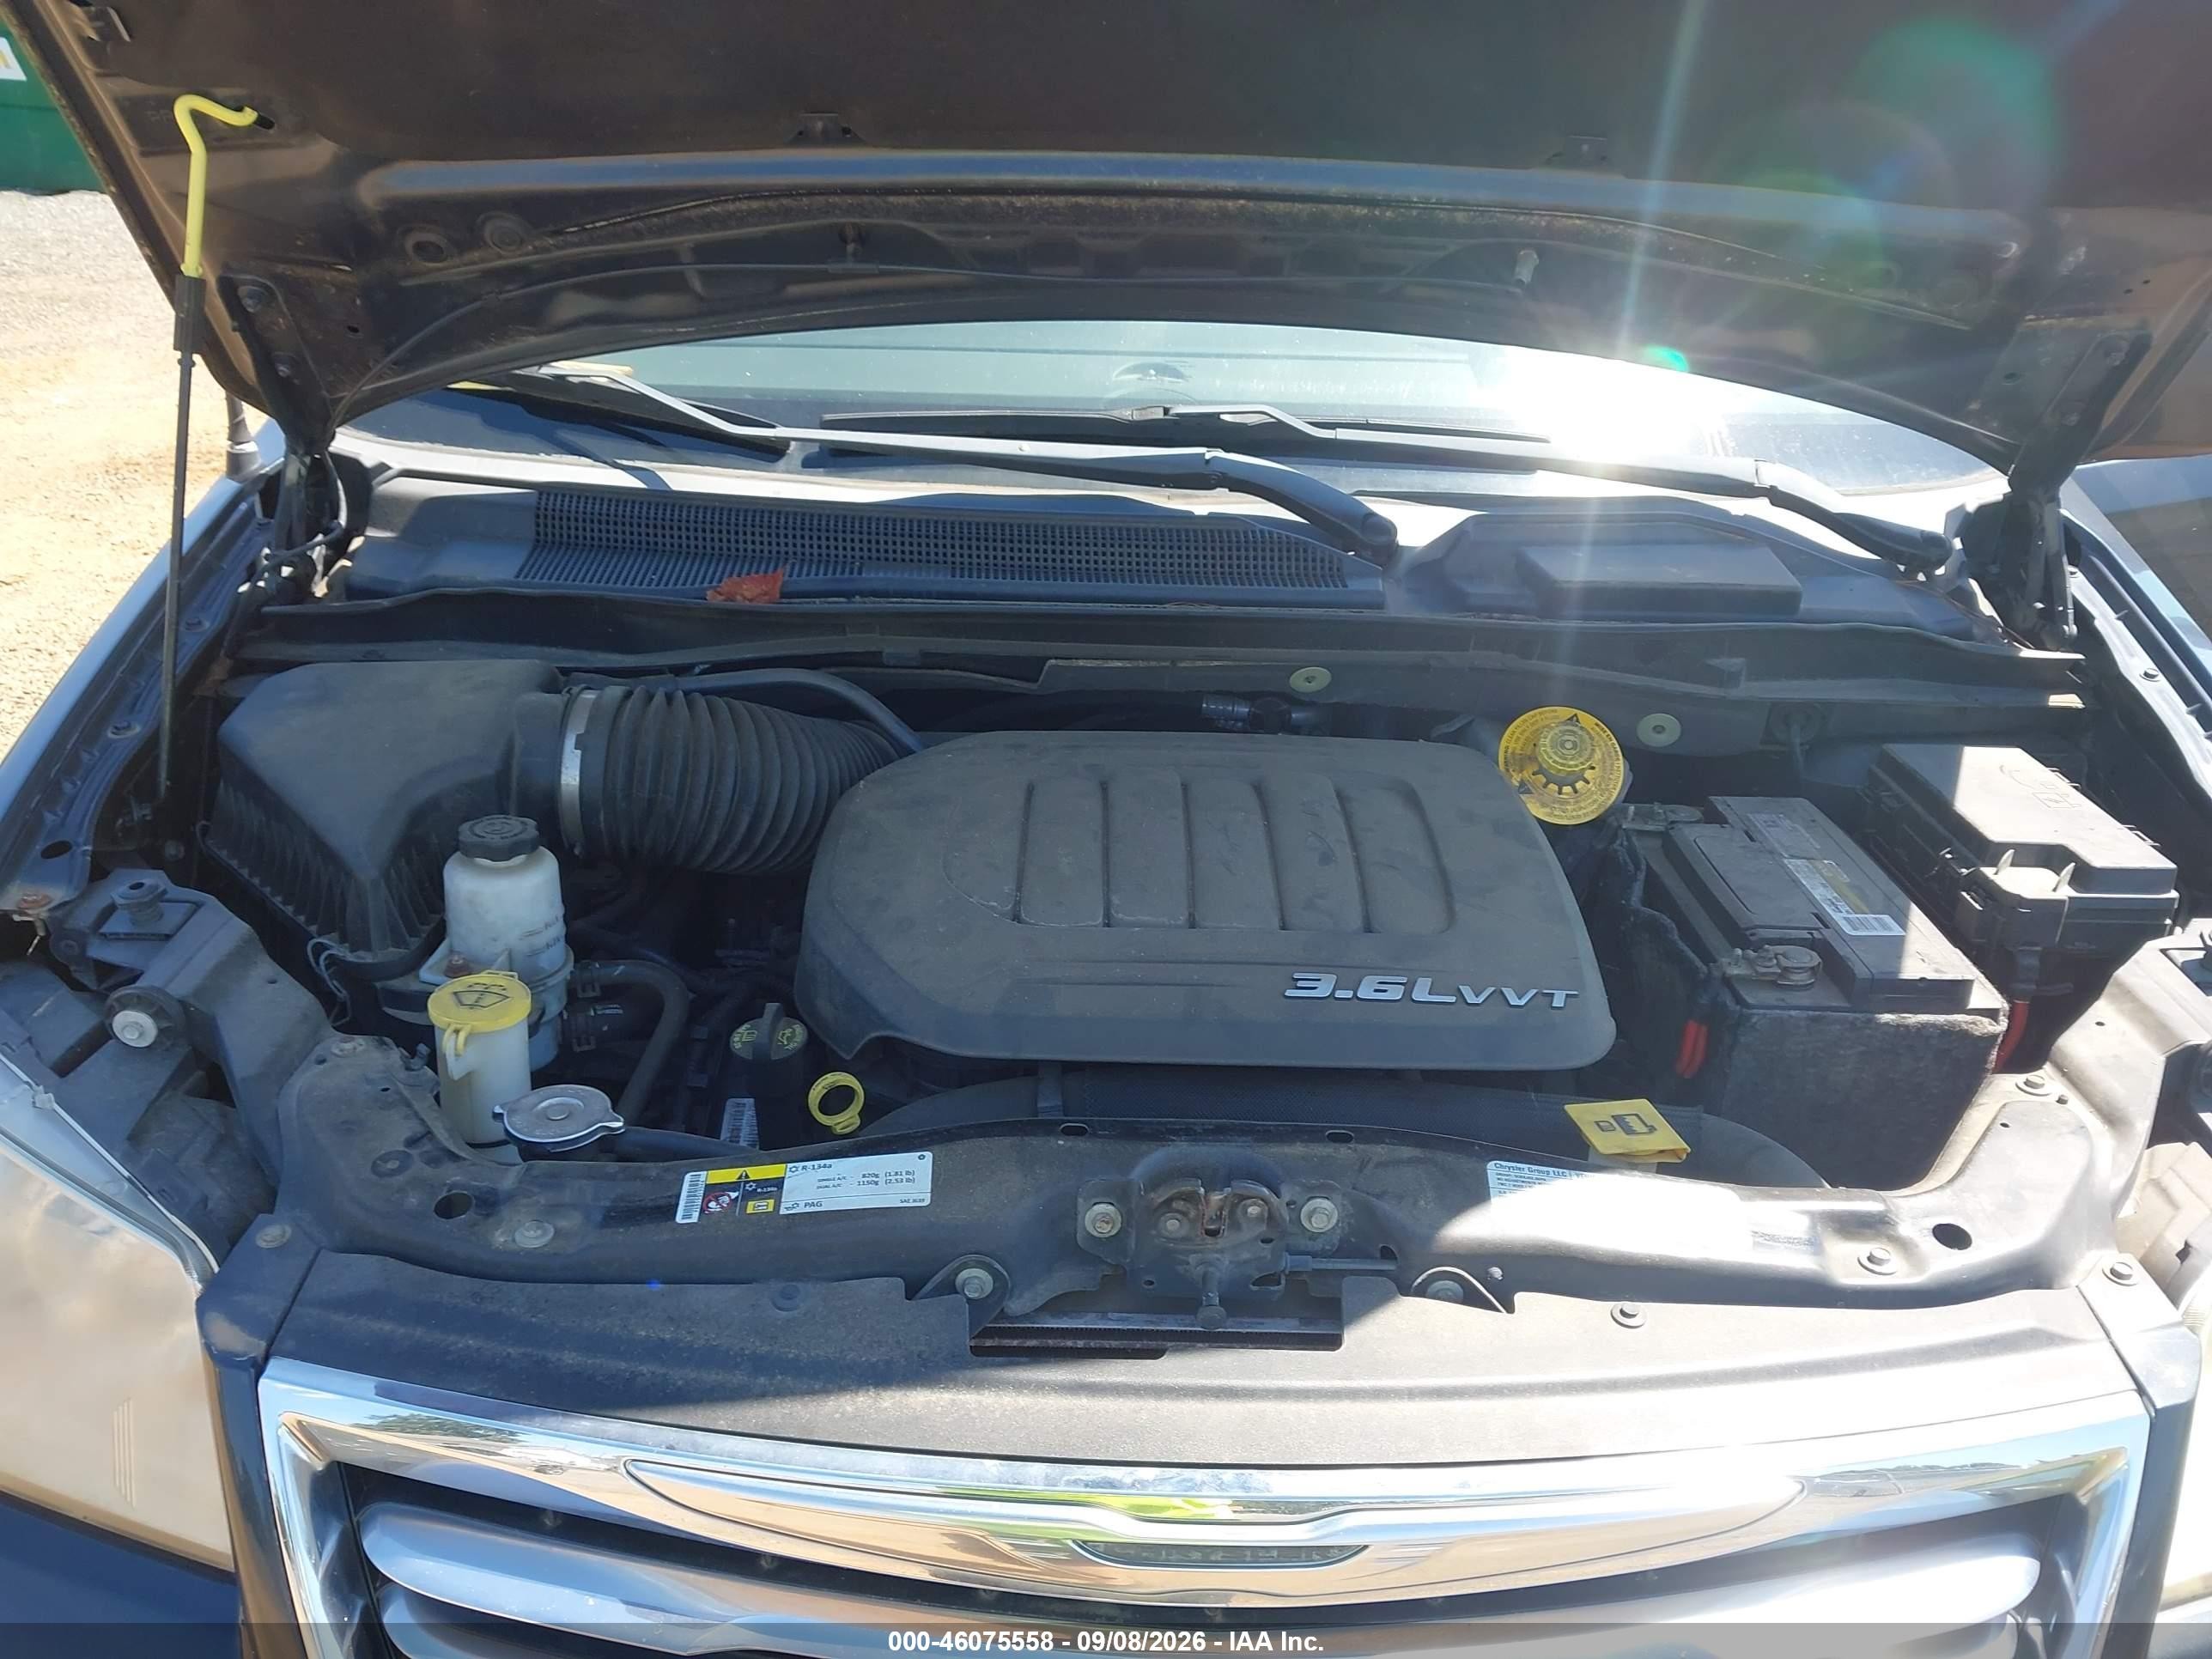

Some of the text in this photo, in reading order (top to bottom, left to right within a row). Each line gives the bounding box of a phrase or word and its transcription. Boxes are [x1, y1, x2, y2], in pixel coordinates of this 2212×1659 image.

[1284, 971, 1581, 1009] 3.6L VVT
[801, 1163, 833, 1171] R-134a
[1493, 1163, 1526, 1172] Chrysler
[1528, 1166, 1551, 1176] Group
